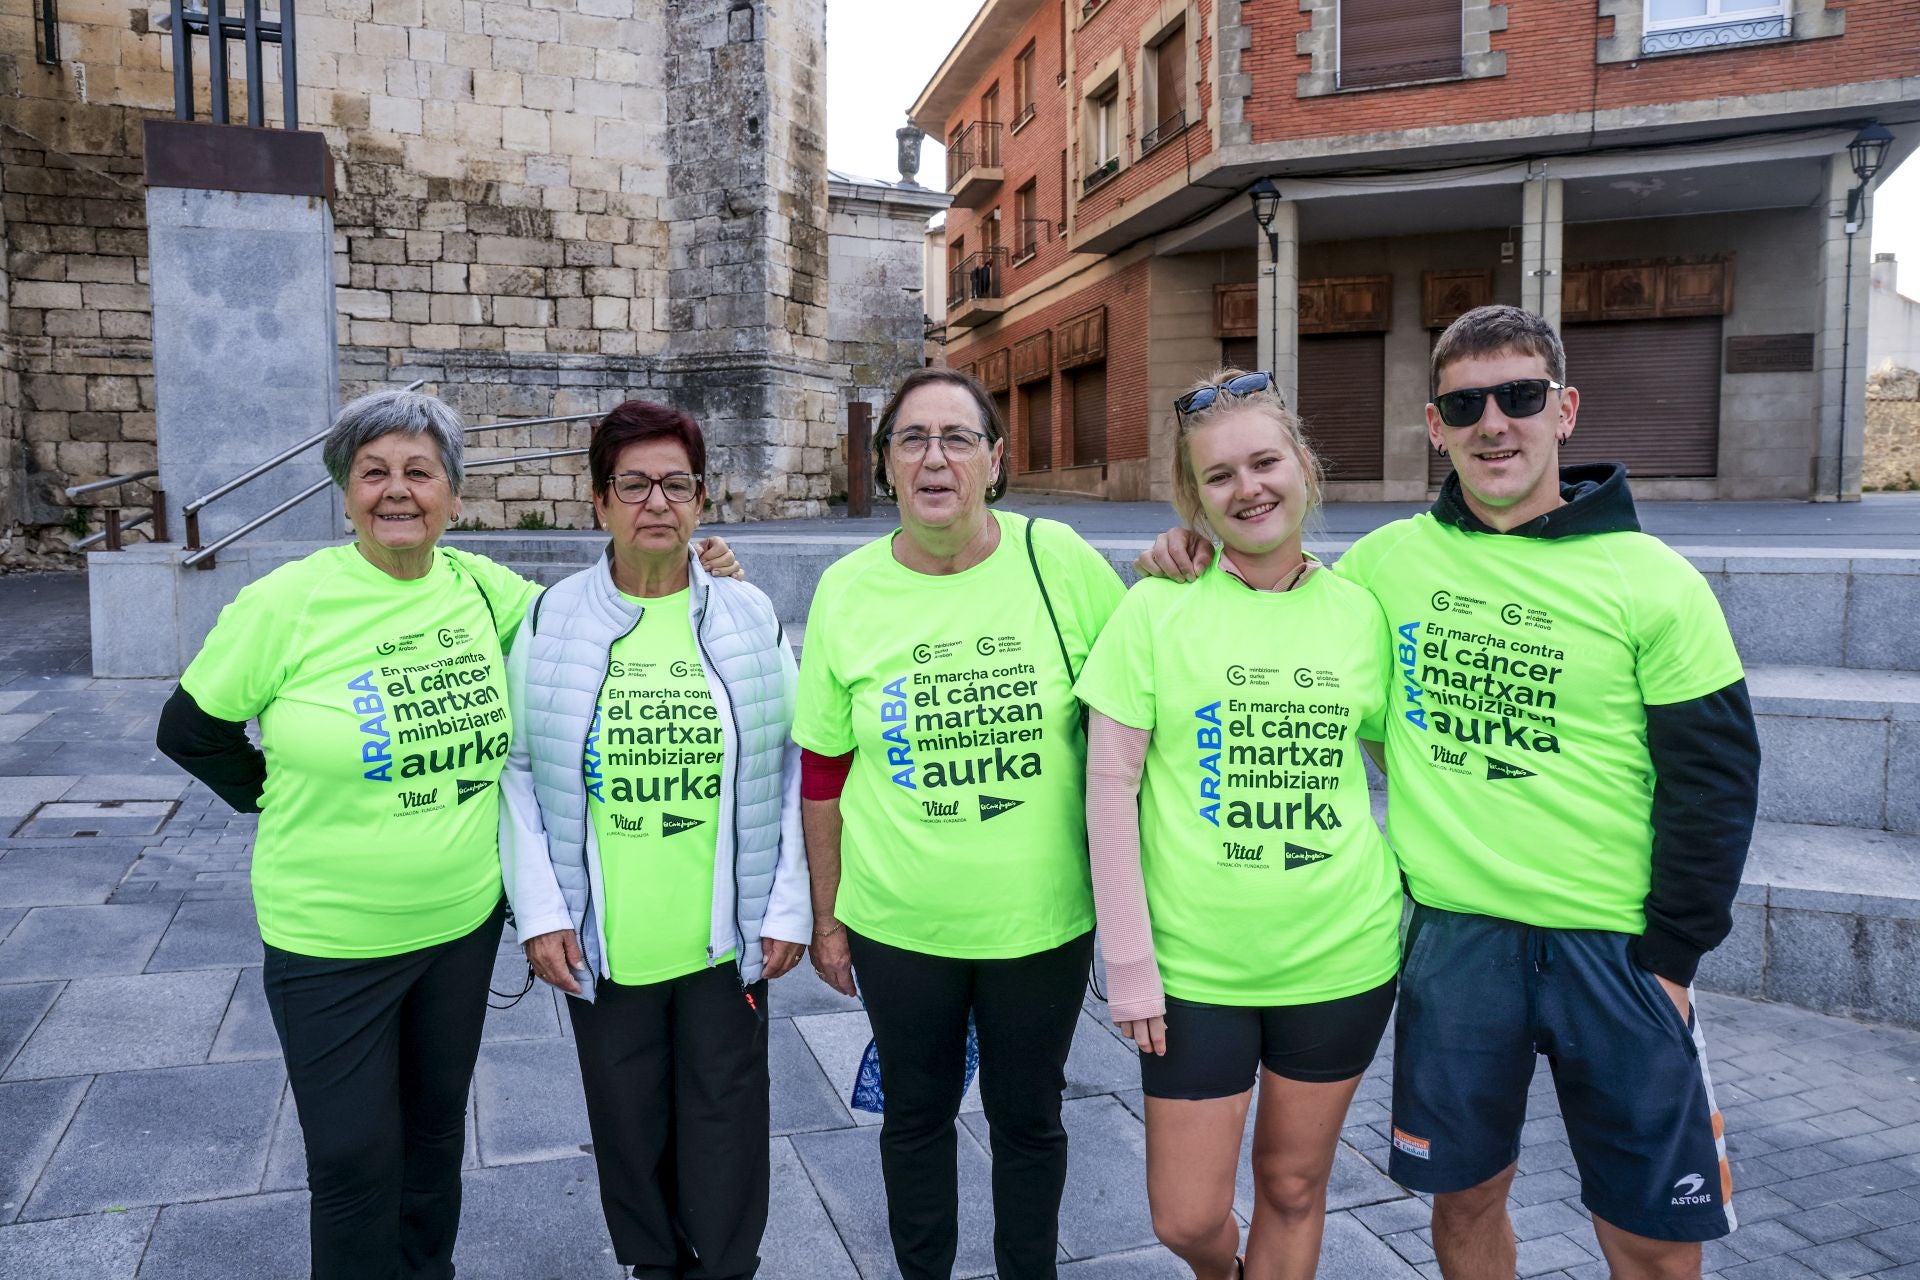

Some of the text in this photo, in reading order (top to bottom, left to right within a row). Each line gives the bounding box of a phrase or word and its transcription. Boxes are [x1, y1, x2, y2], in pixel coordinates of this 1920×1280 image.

[1426, 623, 1564, 660] En marcha contra
[381, 653, 486, 677] En marcha contra
[914, 663, 1035, 684] En marcha contra
[1423, 639, 1562, 684] el cáncer
[387, 664, 491, 697] el cáncer
[914, 680, 1038, 707] el cáncer
[1422, 665, 1556, 709] martxan
[393, 686, 499, 722] martxan
[609, 689, 712, 700] En marcha cont
[608, 700, 717, 720] el cánce
[915, 703, 1042, 732] martxan
[1229, 700, 1349, 717] En marcha contra
[347, 670, 392, 782] ARABA
[398, 707, 506, 744] minbiziaren
[881, 676, 917, 790] ARABA
[1229, 715, 1347, 740] el cáncer
[1430, 711, 1560, 753] aurka
[917, 727, 1042, 751] minbiziaren
[400, 730, 508, 779] aurka
[1195, 701, 1222, 827] ARABA
[1229, 742, 1344, 768] martxan
[1431, 744, 1467, 766] Vital
[922, 748, 1042, 788] aurka
[1227, 770, 1339, 790] minbiziarn
[611, 768, 720, 802] aurka
[398, 788, 438, 809] Vital
[922, 800, 959, 816] Vital
[611, 814, 643, 831] Vital
[1223, 842, 1263, 860] Vital
[1672, 1194, 1711, 1205] ASTORE
